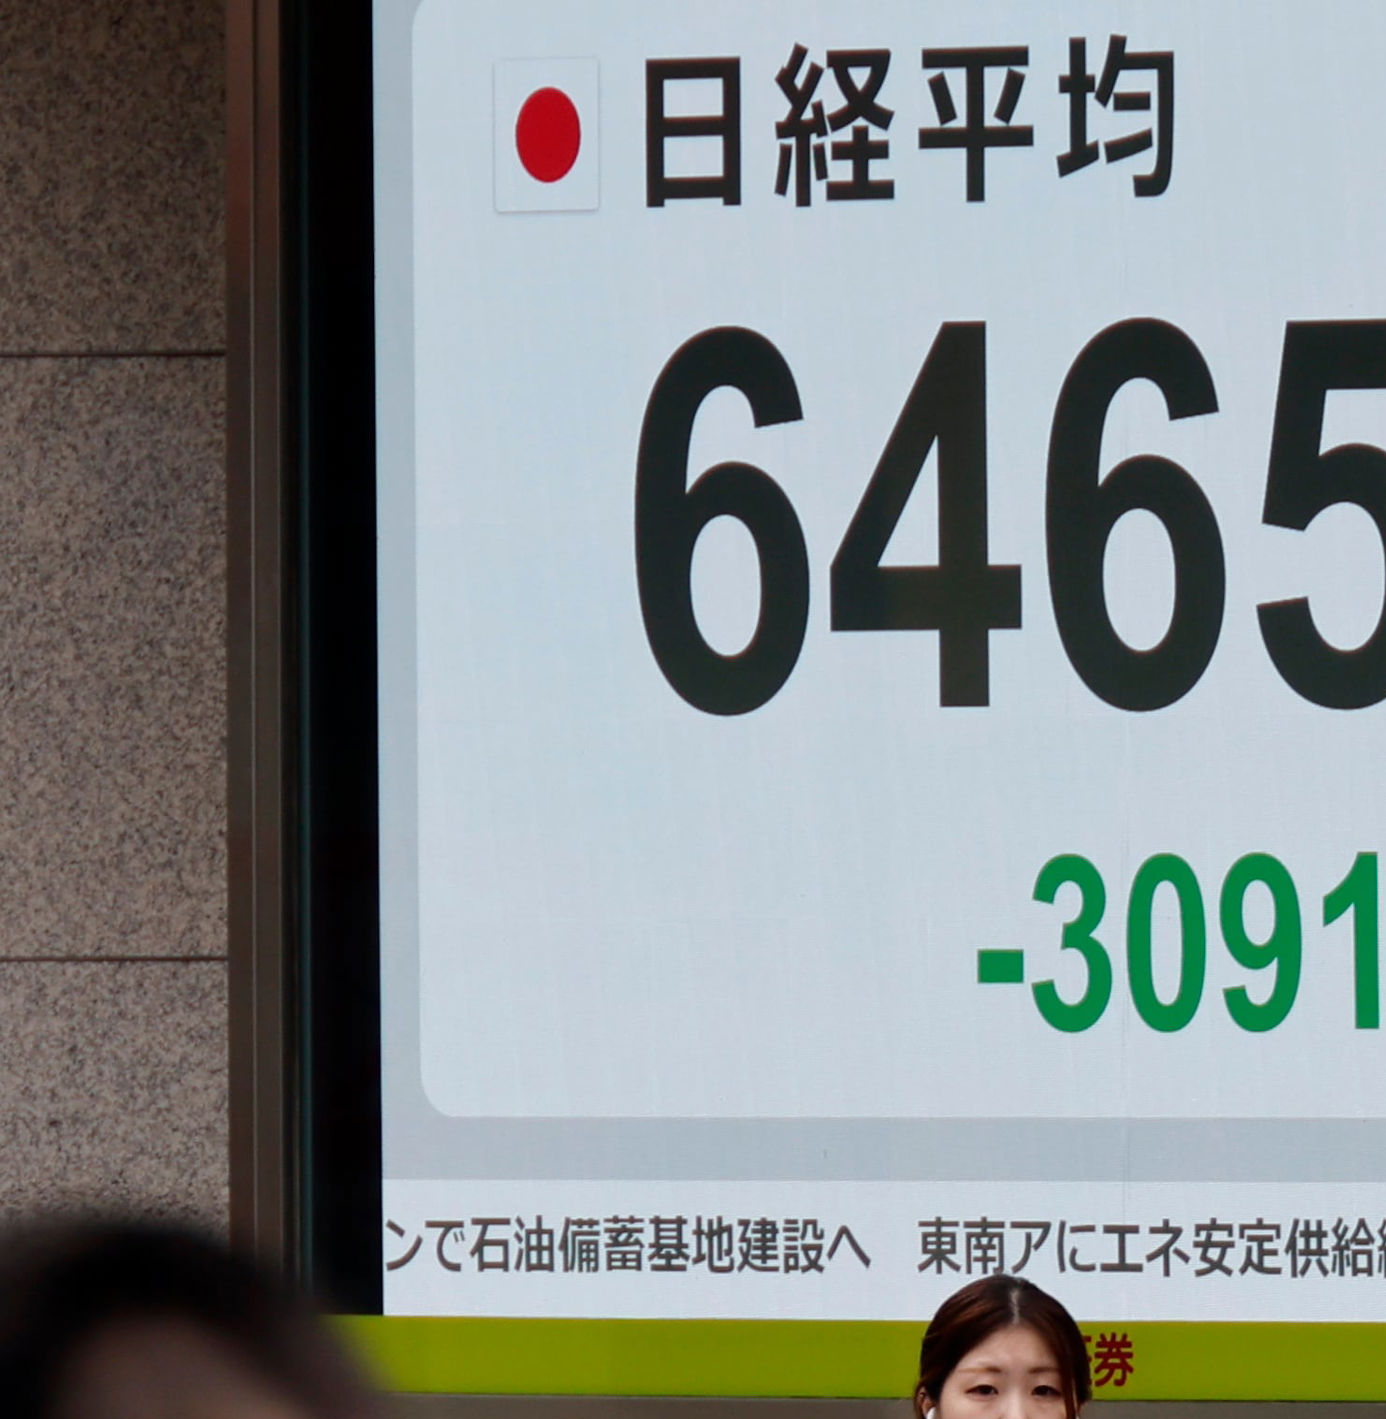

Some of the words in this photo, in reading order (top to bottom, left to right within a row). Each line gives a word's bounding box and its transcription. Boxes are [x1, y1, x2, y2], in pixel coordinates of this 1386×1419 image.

[645, 34, 1175, 208] 日経平均
[386, 1215, 871, 1274] ンで石油備蓄基地建設へ
